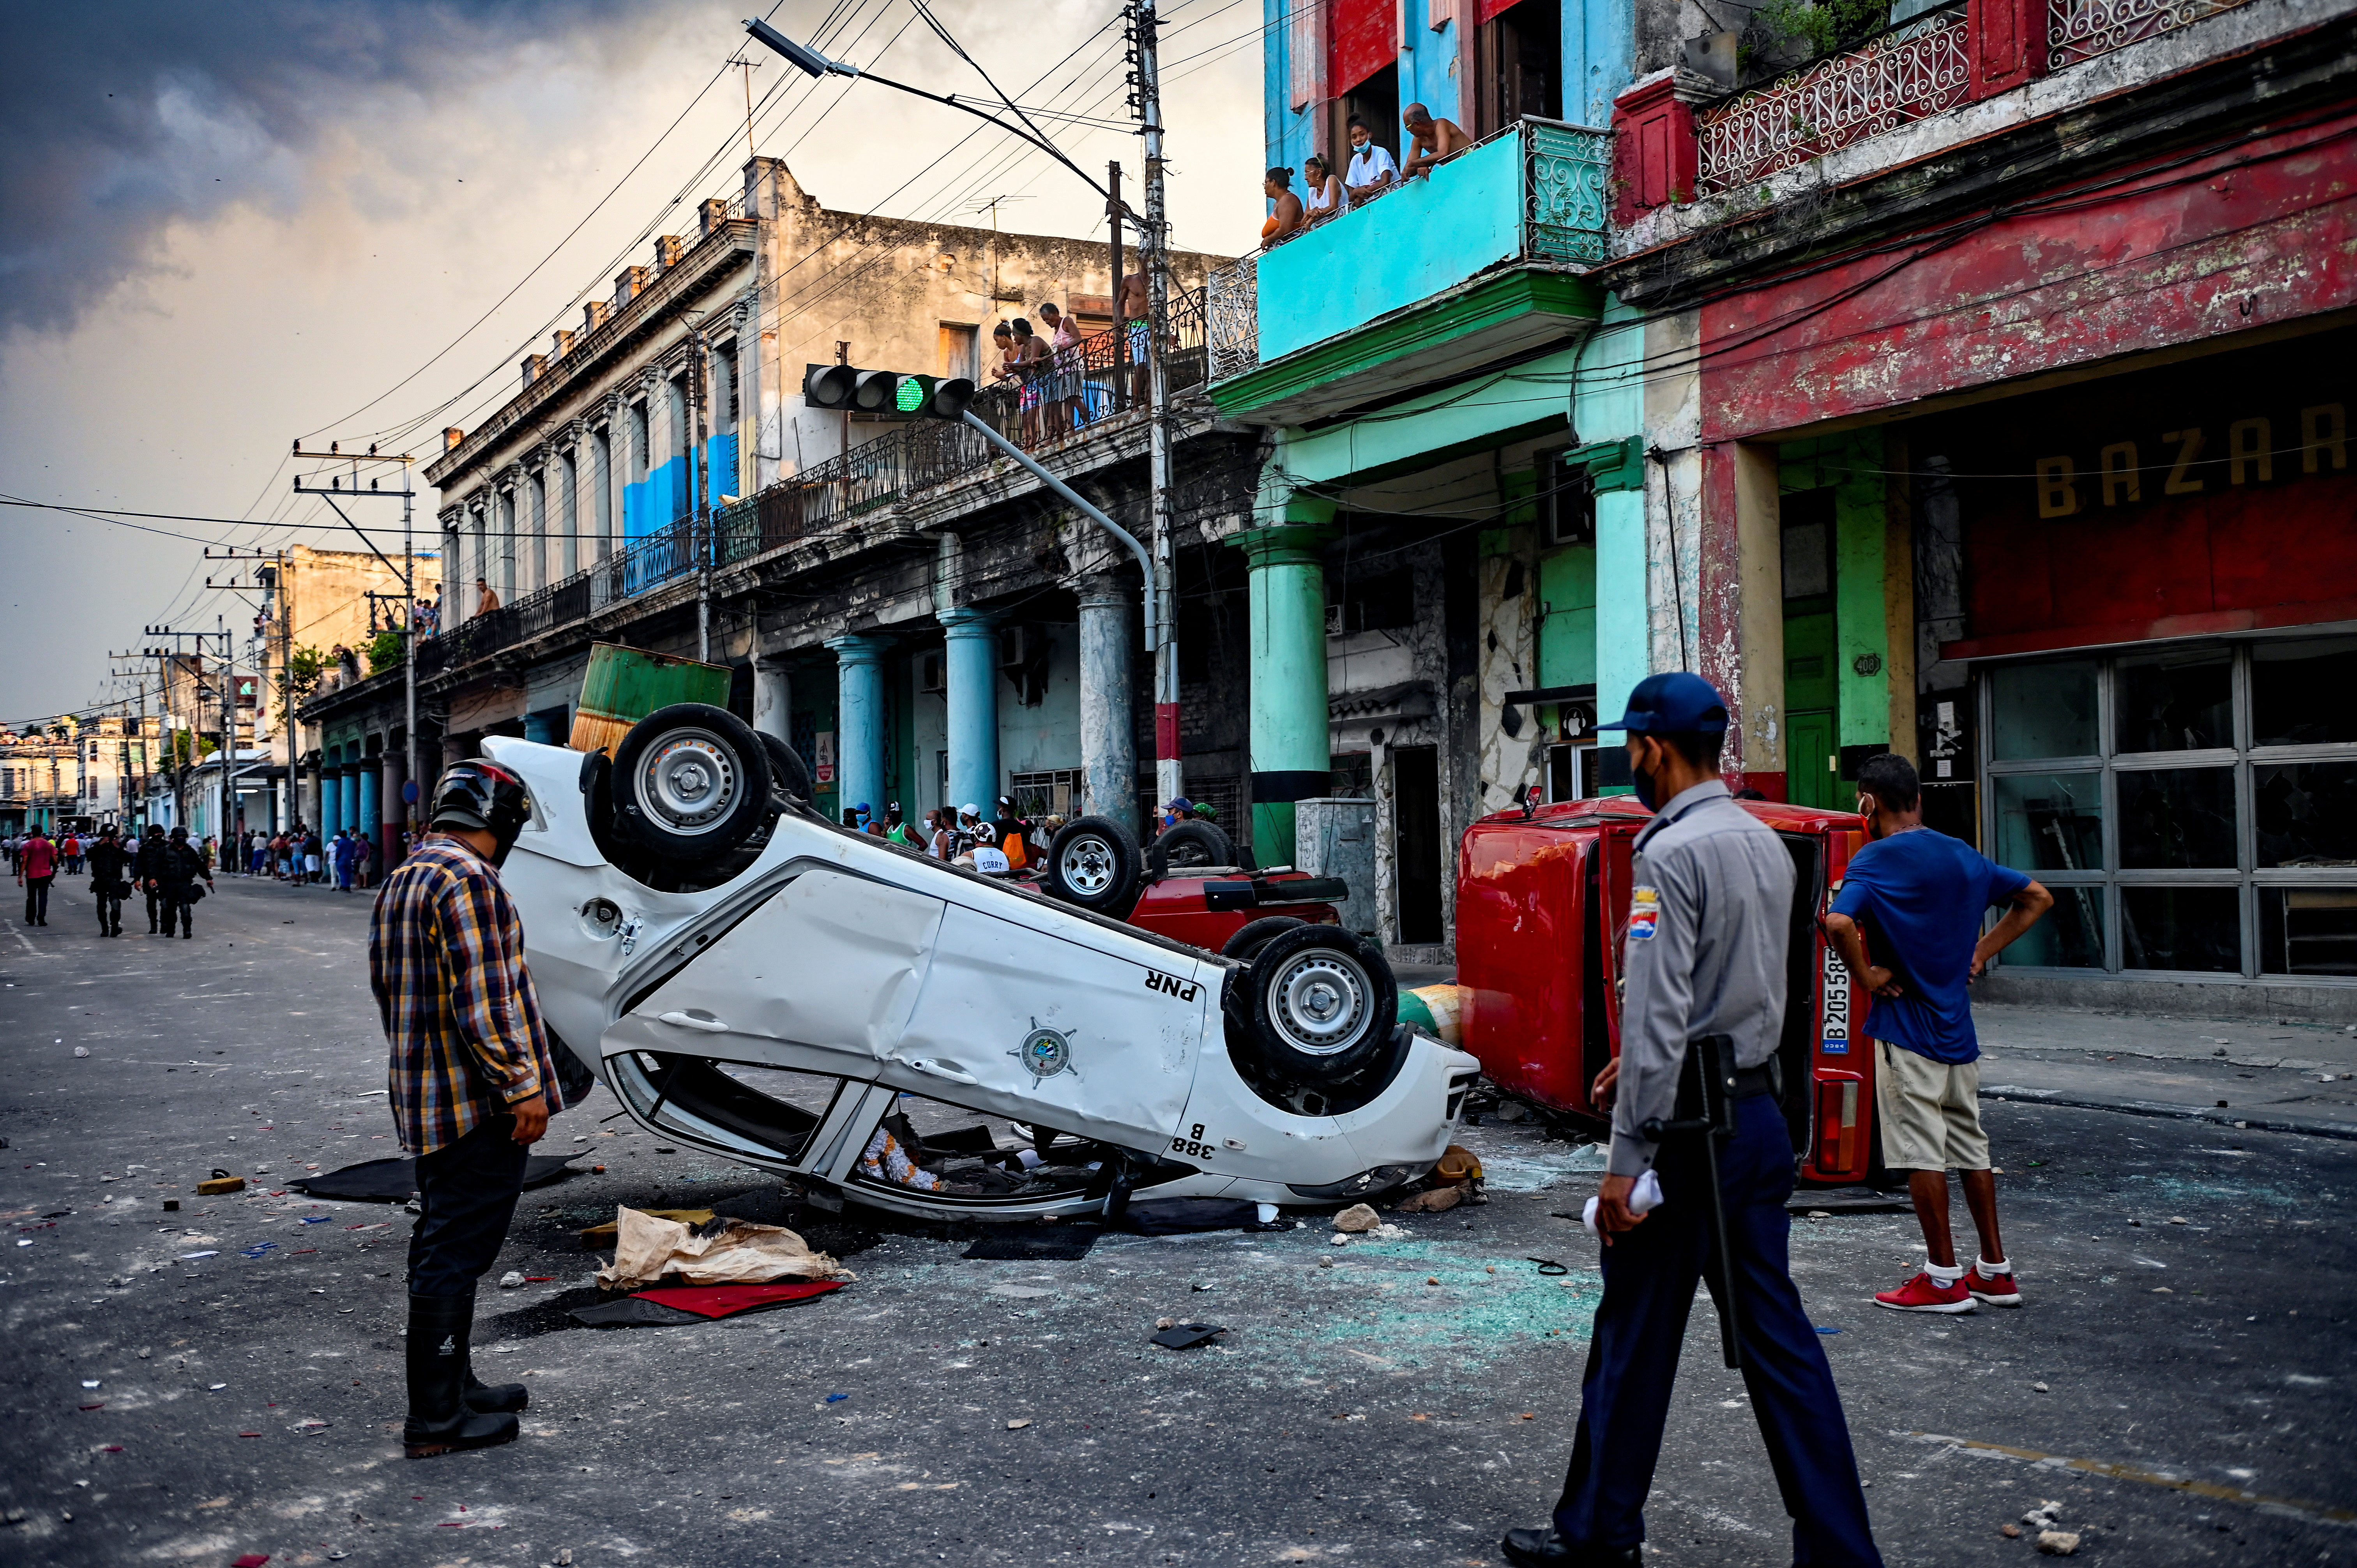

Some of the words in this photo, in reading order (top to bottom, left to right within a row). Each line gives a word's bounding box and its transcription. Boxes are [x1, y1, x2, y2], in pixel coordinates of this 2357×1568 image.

[2035, 403, 2347, 519] BAZAR
[1857, 659, 1874, 672] 408
[982, 861, 1002, 869] CURRY
[1145, 970, 1198, 1003] PNR
[1827, 989, 1846, 1024] 205
[1827, 1028, 1845, 1039] B
[1023, 1047, 1067, 1075] PATRULLA
[1191, 1123, 1205, 1141] B
[1172, 1137, 1216, 1160] 388
